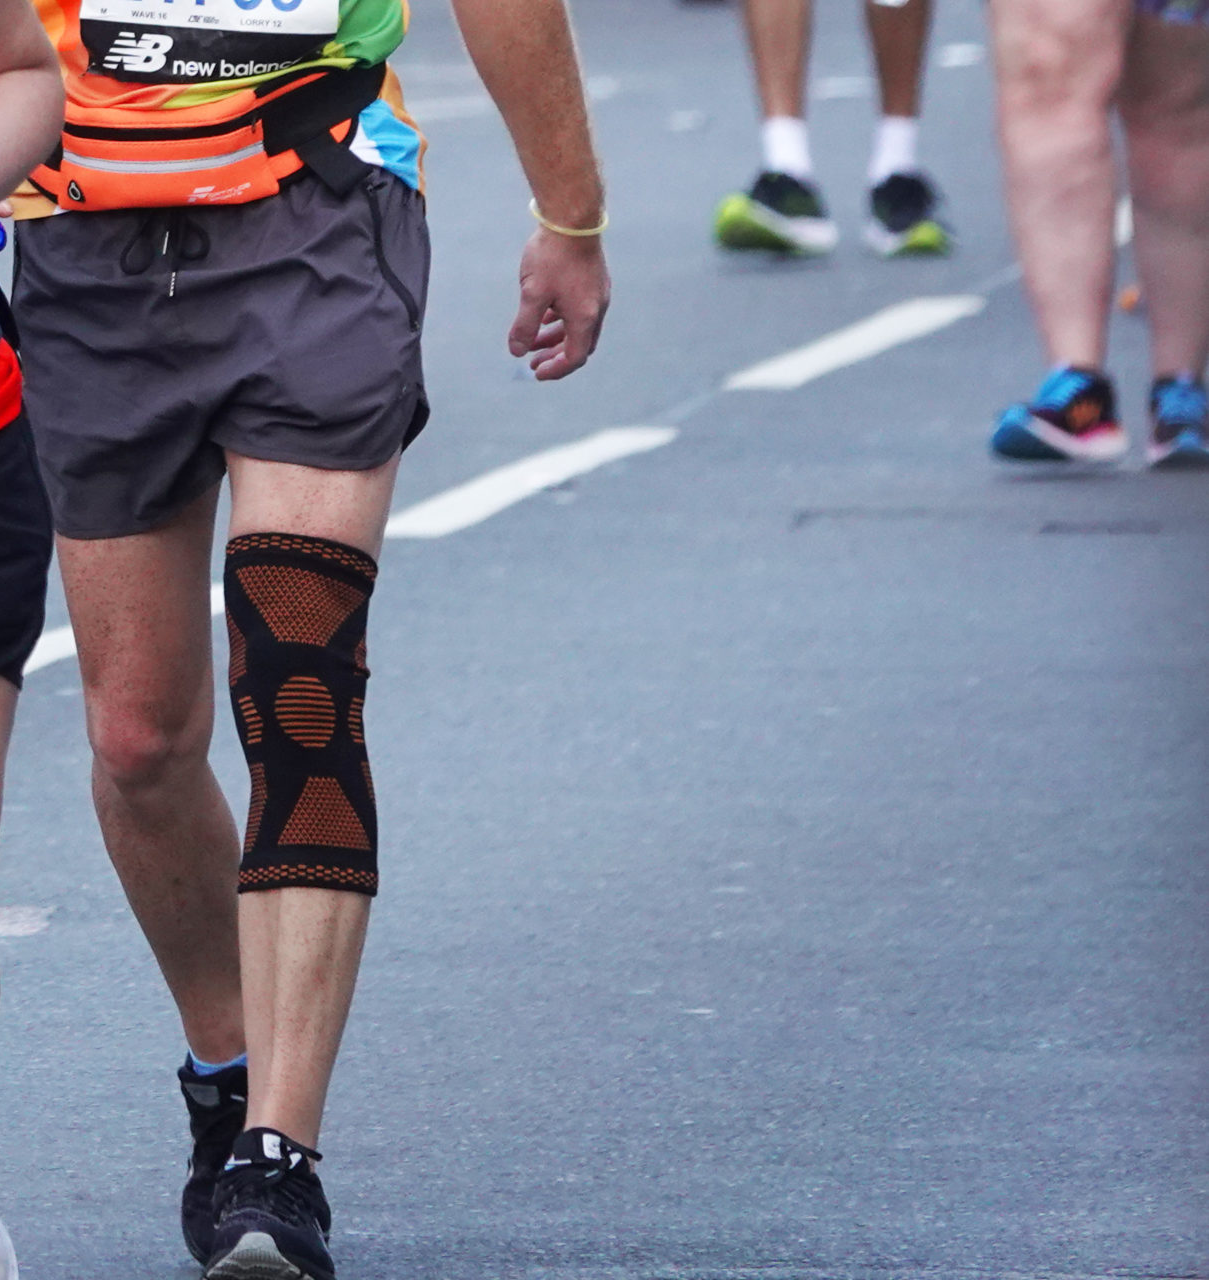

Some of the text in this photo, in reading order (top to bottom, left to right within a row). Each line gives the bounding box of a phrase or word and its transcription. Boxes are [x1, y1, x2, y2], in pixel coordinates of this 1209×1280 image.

[131, 10, 155, 19] WAVE
[240, 19, 269, 27] LORRY
[172, 57, 302, 77] new balanc
